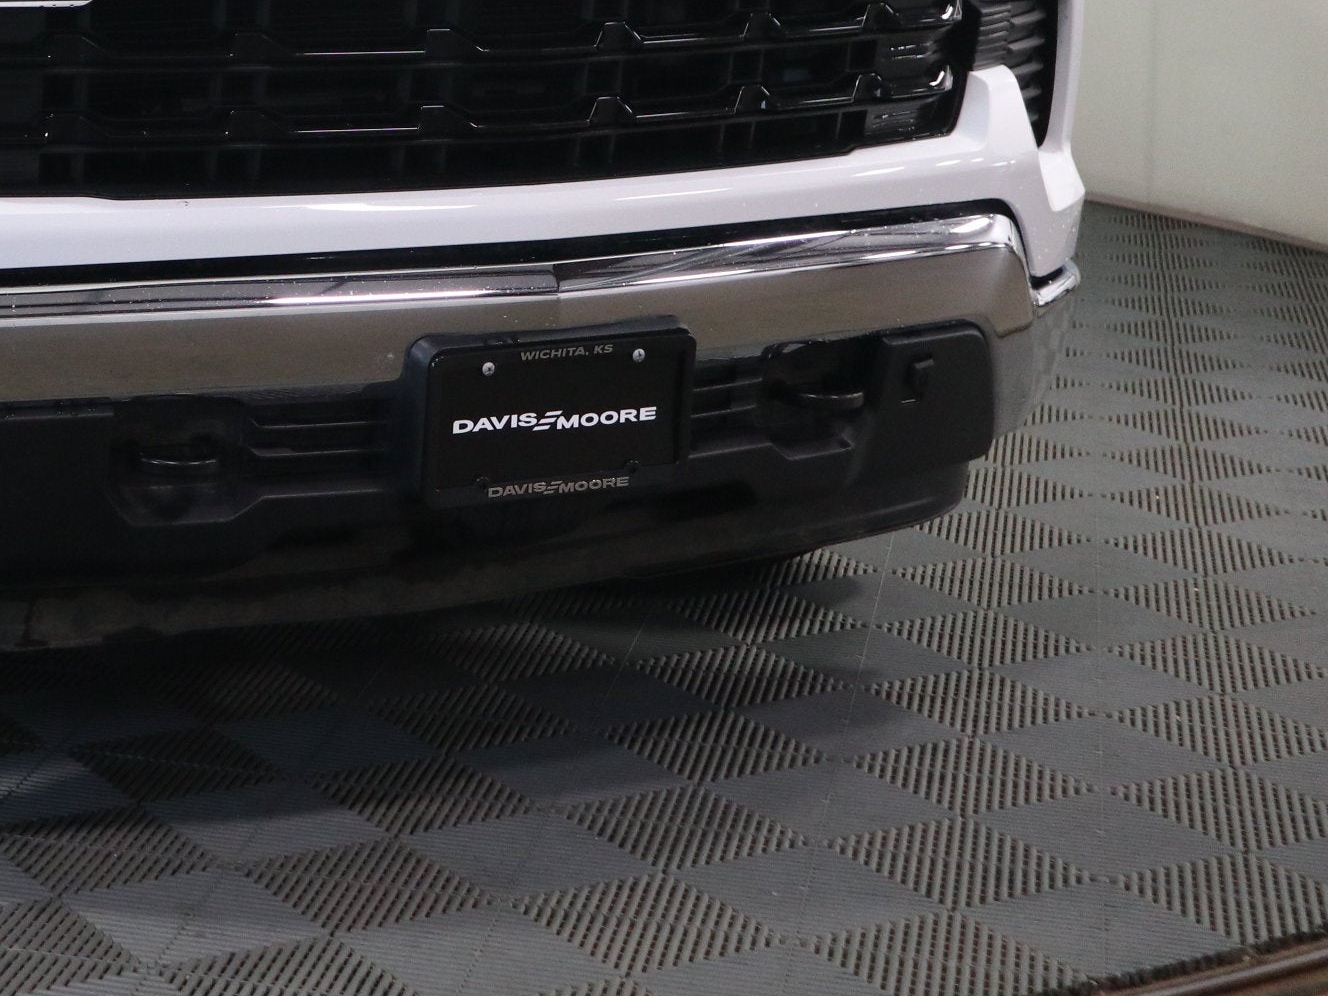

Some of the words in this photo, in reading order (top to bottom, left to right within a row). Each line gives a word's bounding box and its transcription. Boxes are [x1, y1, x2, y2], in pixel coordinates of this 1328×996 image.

[593, 344, 614, 354] KS
[452, 412, 538, 435] DAVIS
[556, 406, 657, 430] MOORE
[488, 481, 547, 498] DAVIS
[558, 476, 629, 493] MOORE
